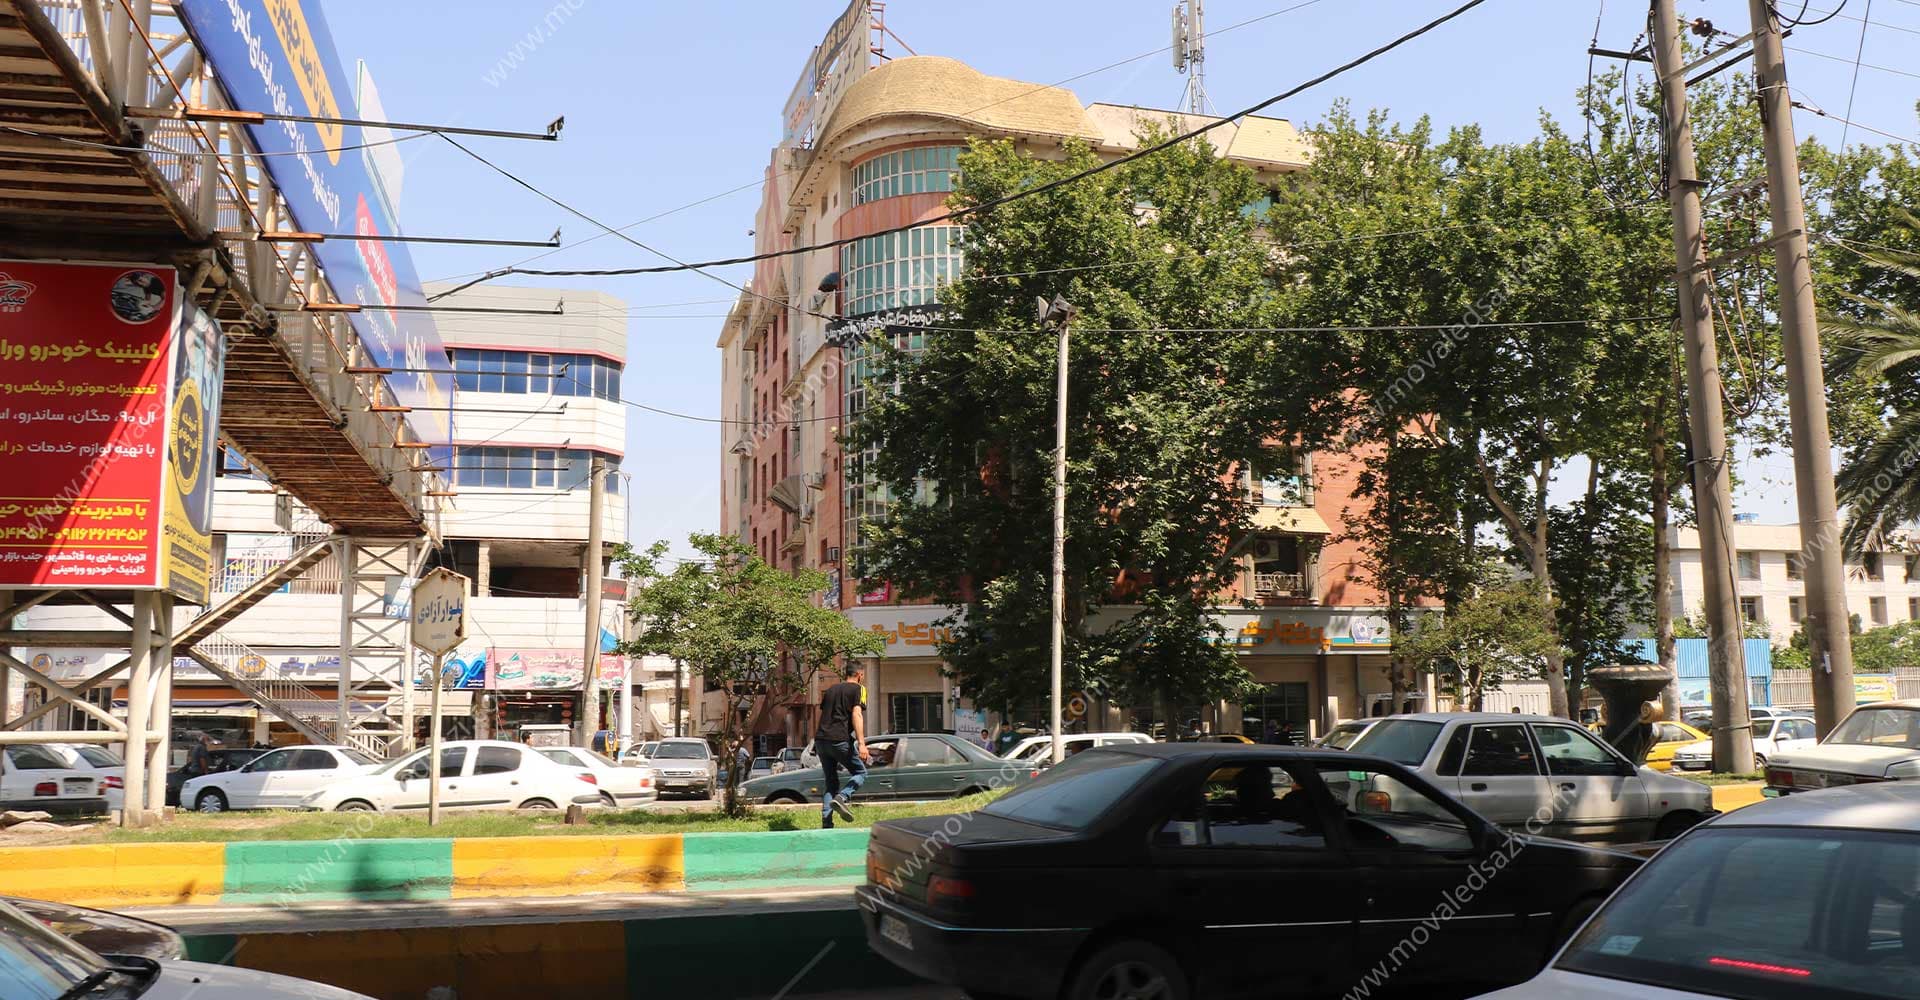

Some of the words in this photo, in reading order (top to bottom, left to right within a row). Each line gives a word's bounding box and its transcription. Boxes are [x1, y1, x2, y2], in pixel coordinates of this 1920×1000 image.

[29, 339, 91, 362] خودرو
[96, 342, 160, 363] کلینیک
[14, 380, 65, 395] گیربکس
[106, 383, 157, 397] تعمیرات
[139, 411, 155, 426] ال
[10, 444, 24, 456] در
[27, 441, 76, 454] خدمات
[79, 442, 112, 457] لوازم
[114, 444, 143, 458] تهیه
[145, 444, 156, 457] با
[136, 504, 147, 520] با
[120, 554, 147, 564] اتوبان
[86, 564, 114, 576] خودرو
[417, 594, 443, 625] آزادی
